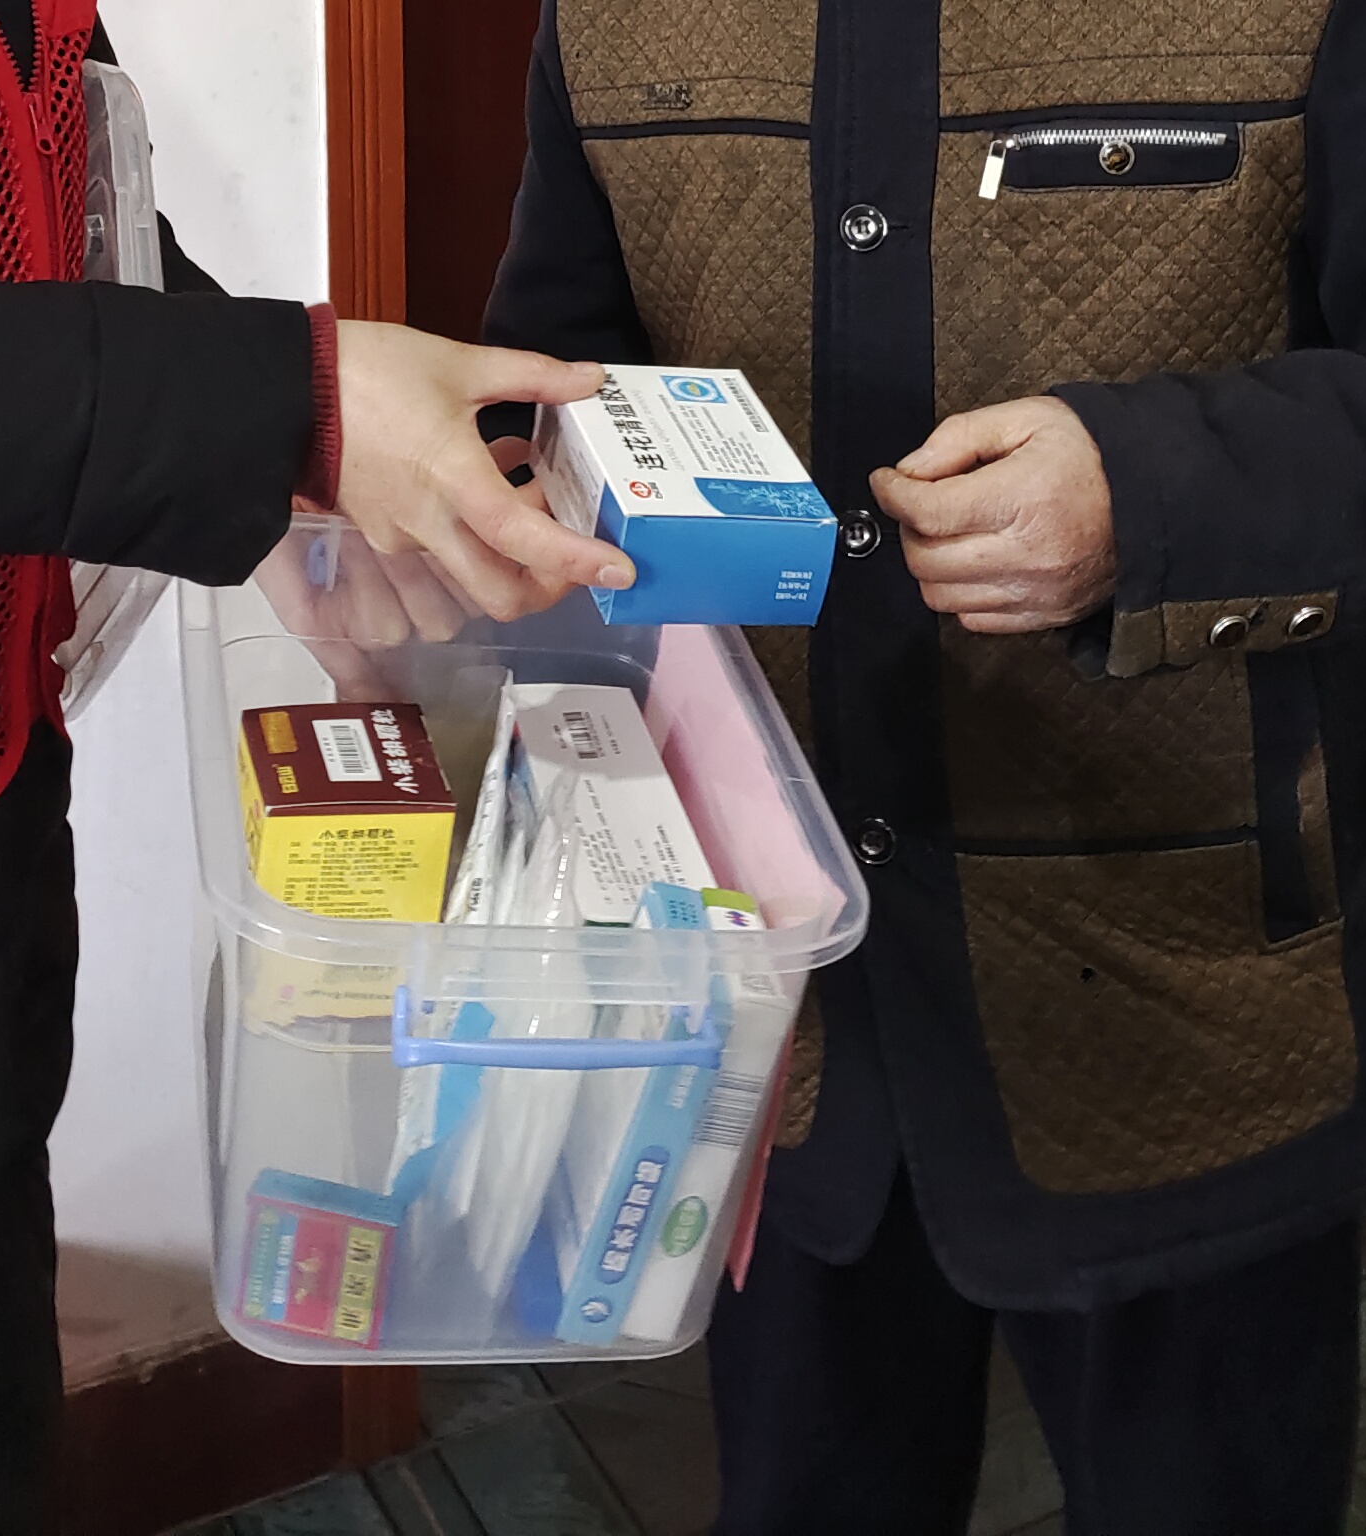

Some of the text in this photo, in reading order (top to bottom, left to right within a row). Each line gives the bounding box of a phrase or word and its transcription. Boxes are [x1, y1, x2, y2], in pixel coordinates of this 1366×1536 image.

[370, 708, 420, 795] 小柴胡颗粒
